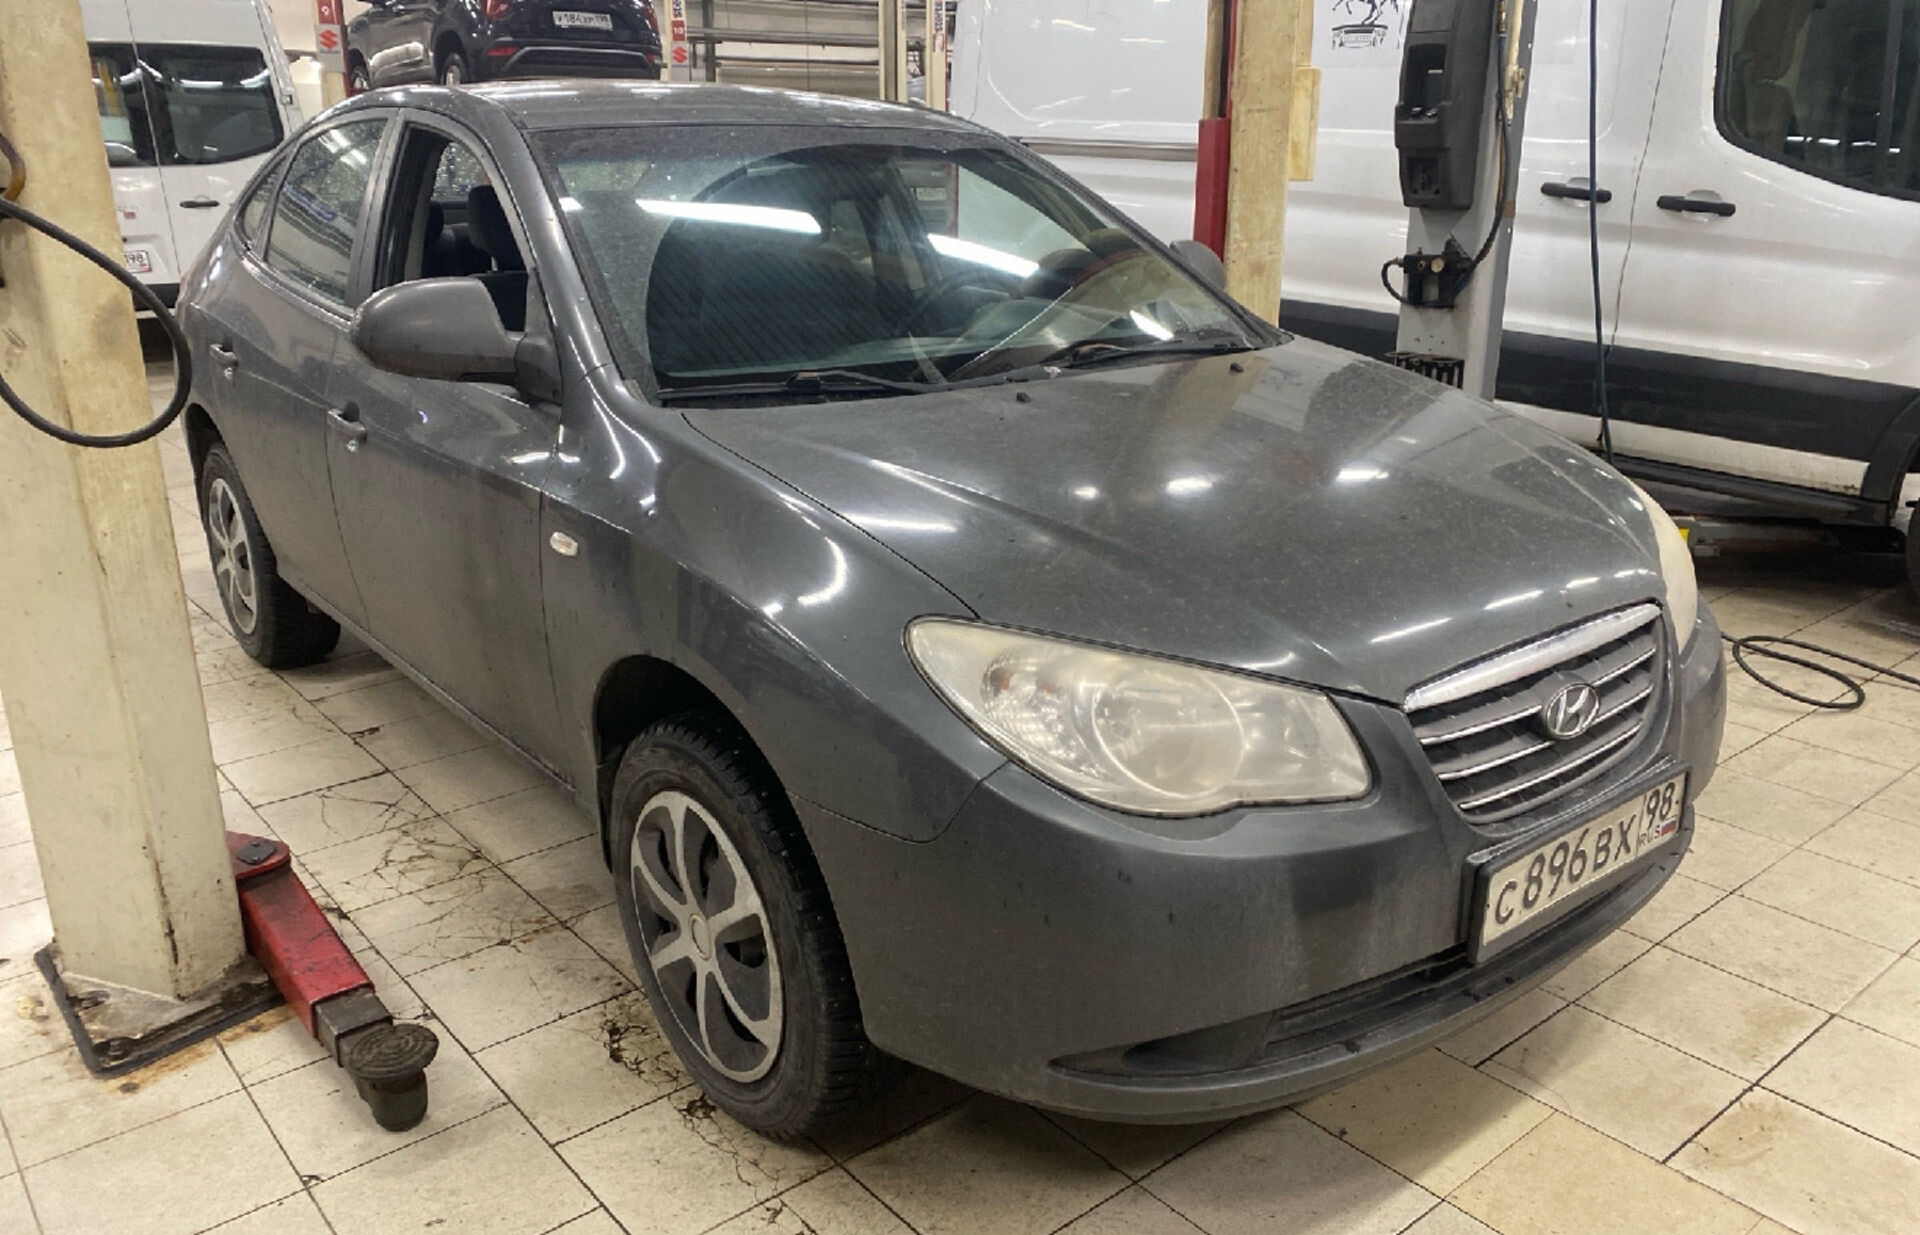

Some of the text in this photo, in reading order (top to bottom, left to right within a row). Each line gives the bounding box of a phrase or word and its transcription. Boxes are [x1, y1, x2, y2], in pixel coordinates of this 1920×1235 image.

[1494, 781, 1676, 925] С896ВХ 98
[1639, 824, 1661, 847] RUS
